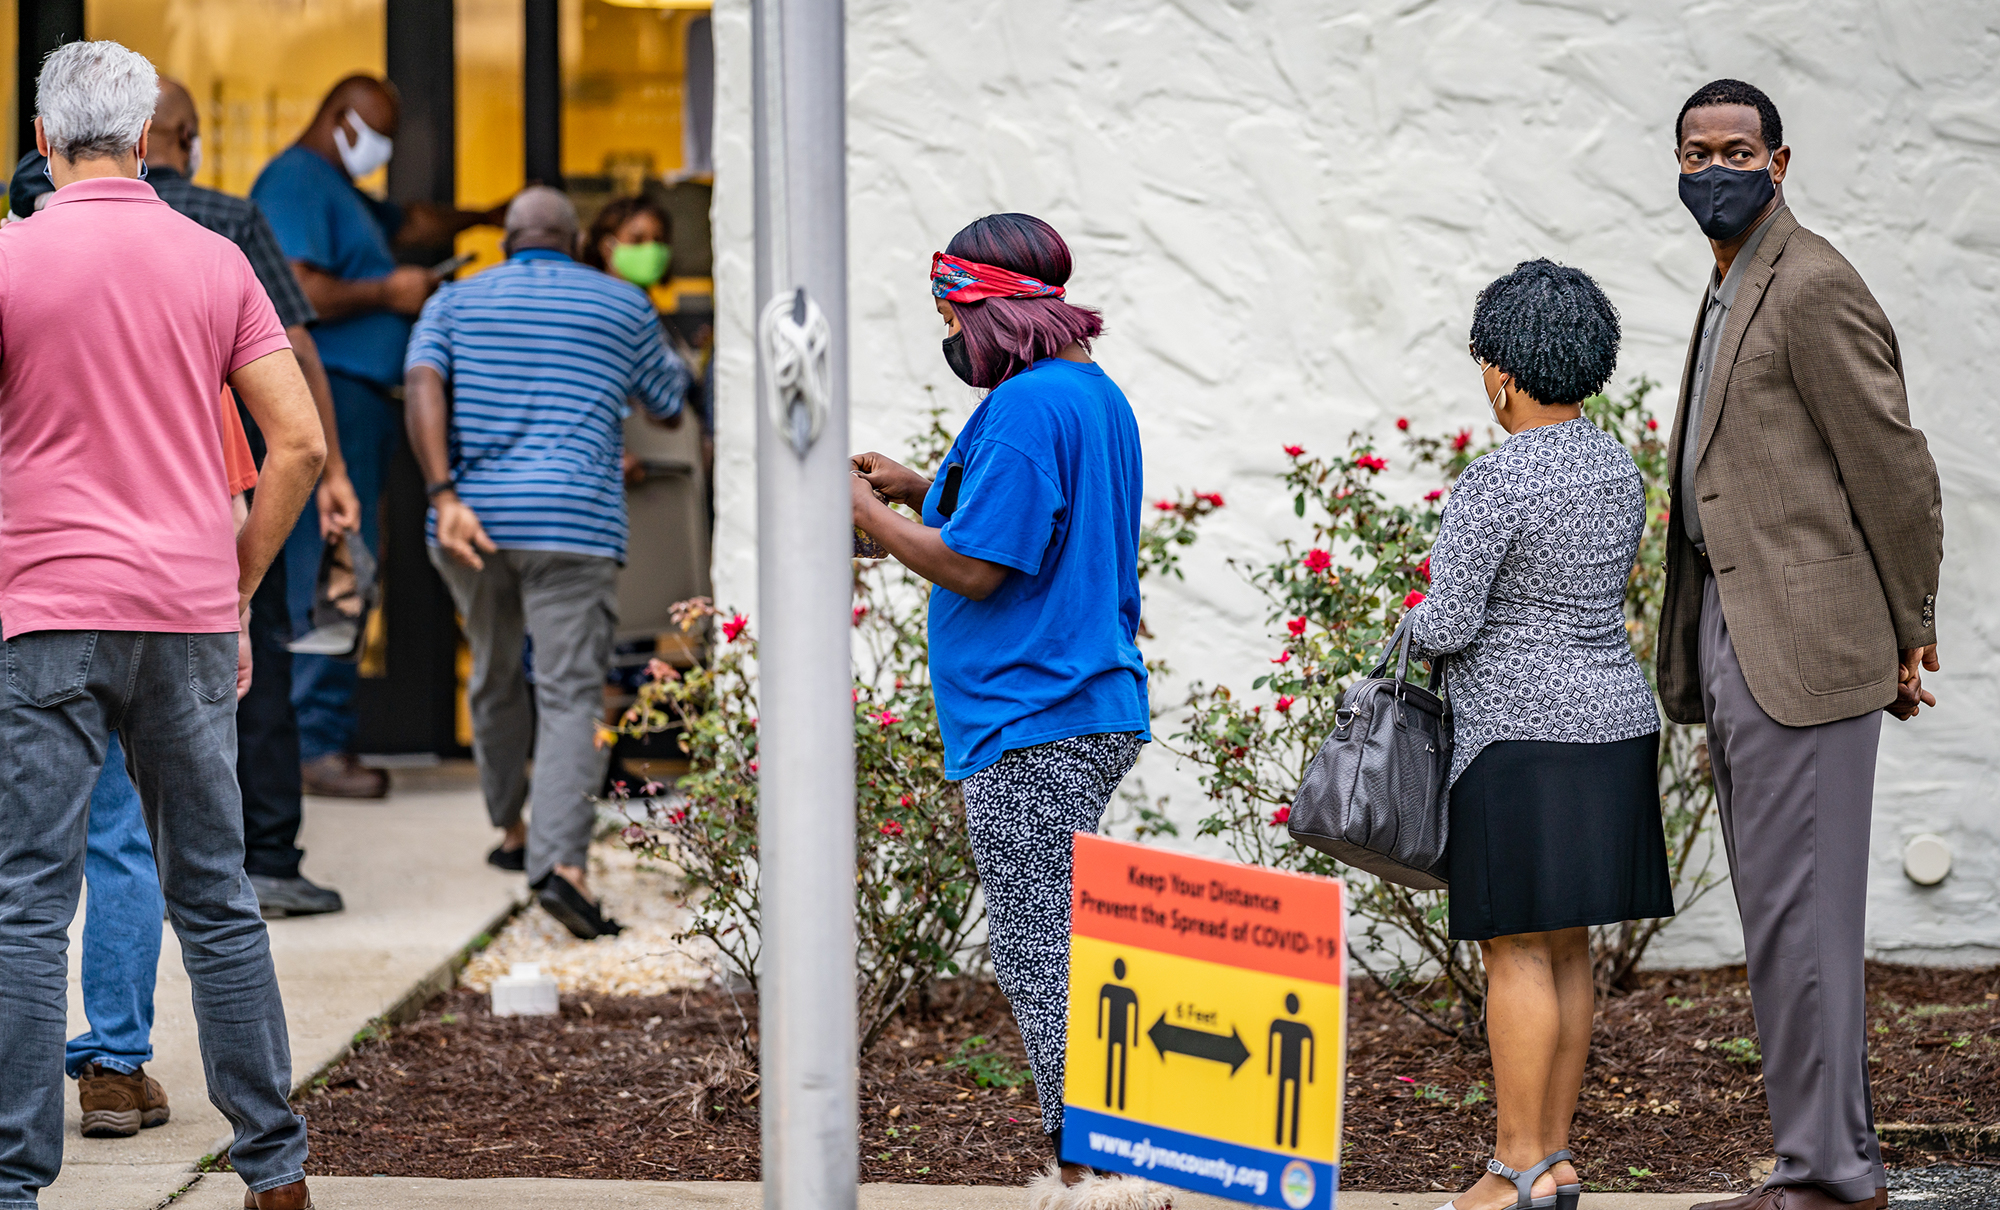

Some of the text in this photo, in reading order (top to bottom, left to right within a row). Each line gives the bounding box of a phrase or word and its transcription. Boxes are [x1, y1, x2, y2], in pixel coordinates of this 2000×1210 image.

[1127, 865, 1281, 913] Keep Your Distance
[1080, 890, 1337, 959] Prevent the Spread of COVID-19
[1176, 1001, 1217, 1026] 6 Feet
[1089, 1130, 1269, 1196] www.glynncounty.org
